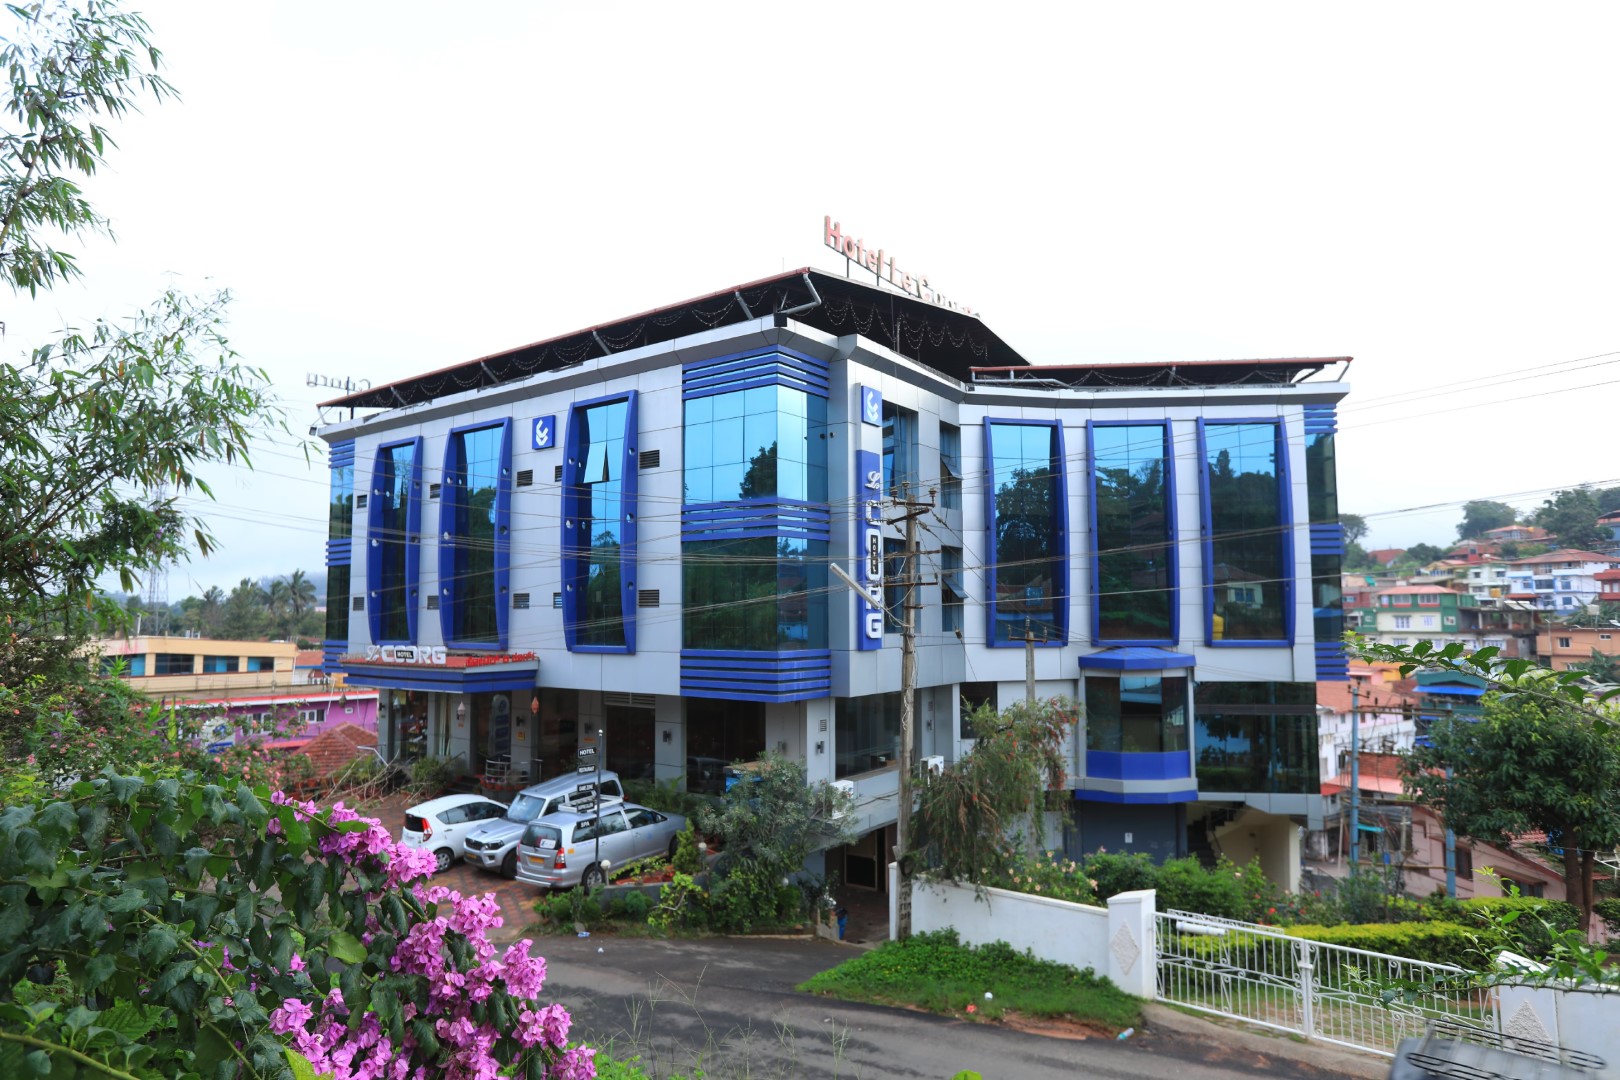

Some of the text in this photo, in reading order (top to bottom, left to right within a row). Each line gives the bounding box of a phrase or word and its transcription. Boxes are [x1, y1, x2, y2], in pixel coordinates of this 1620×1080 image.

[824, 215, 885, 276] Hotel
[889, 256, 912, 292] Le
[381, 645, 447, 664] COORG
[396, 650, 413, 659] HOTEL
[579, 748, 595, 756] HOTEL
